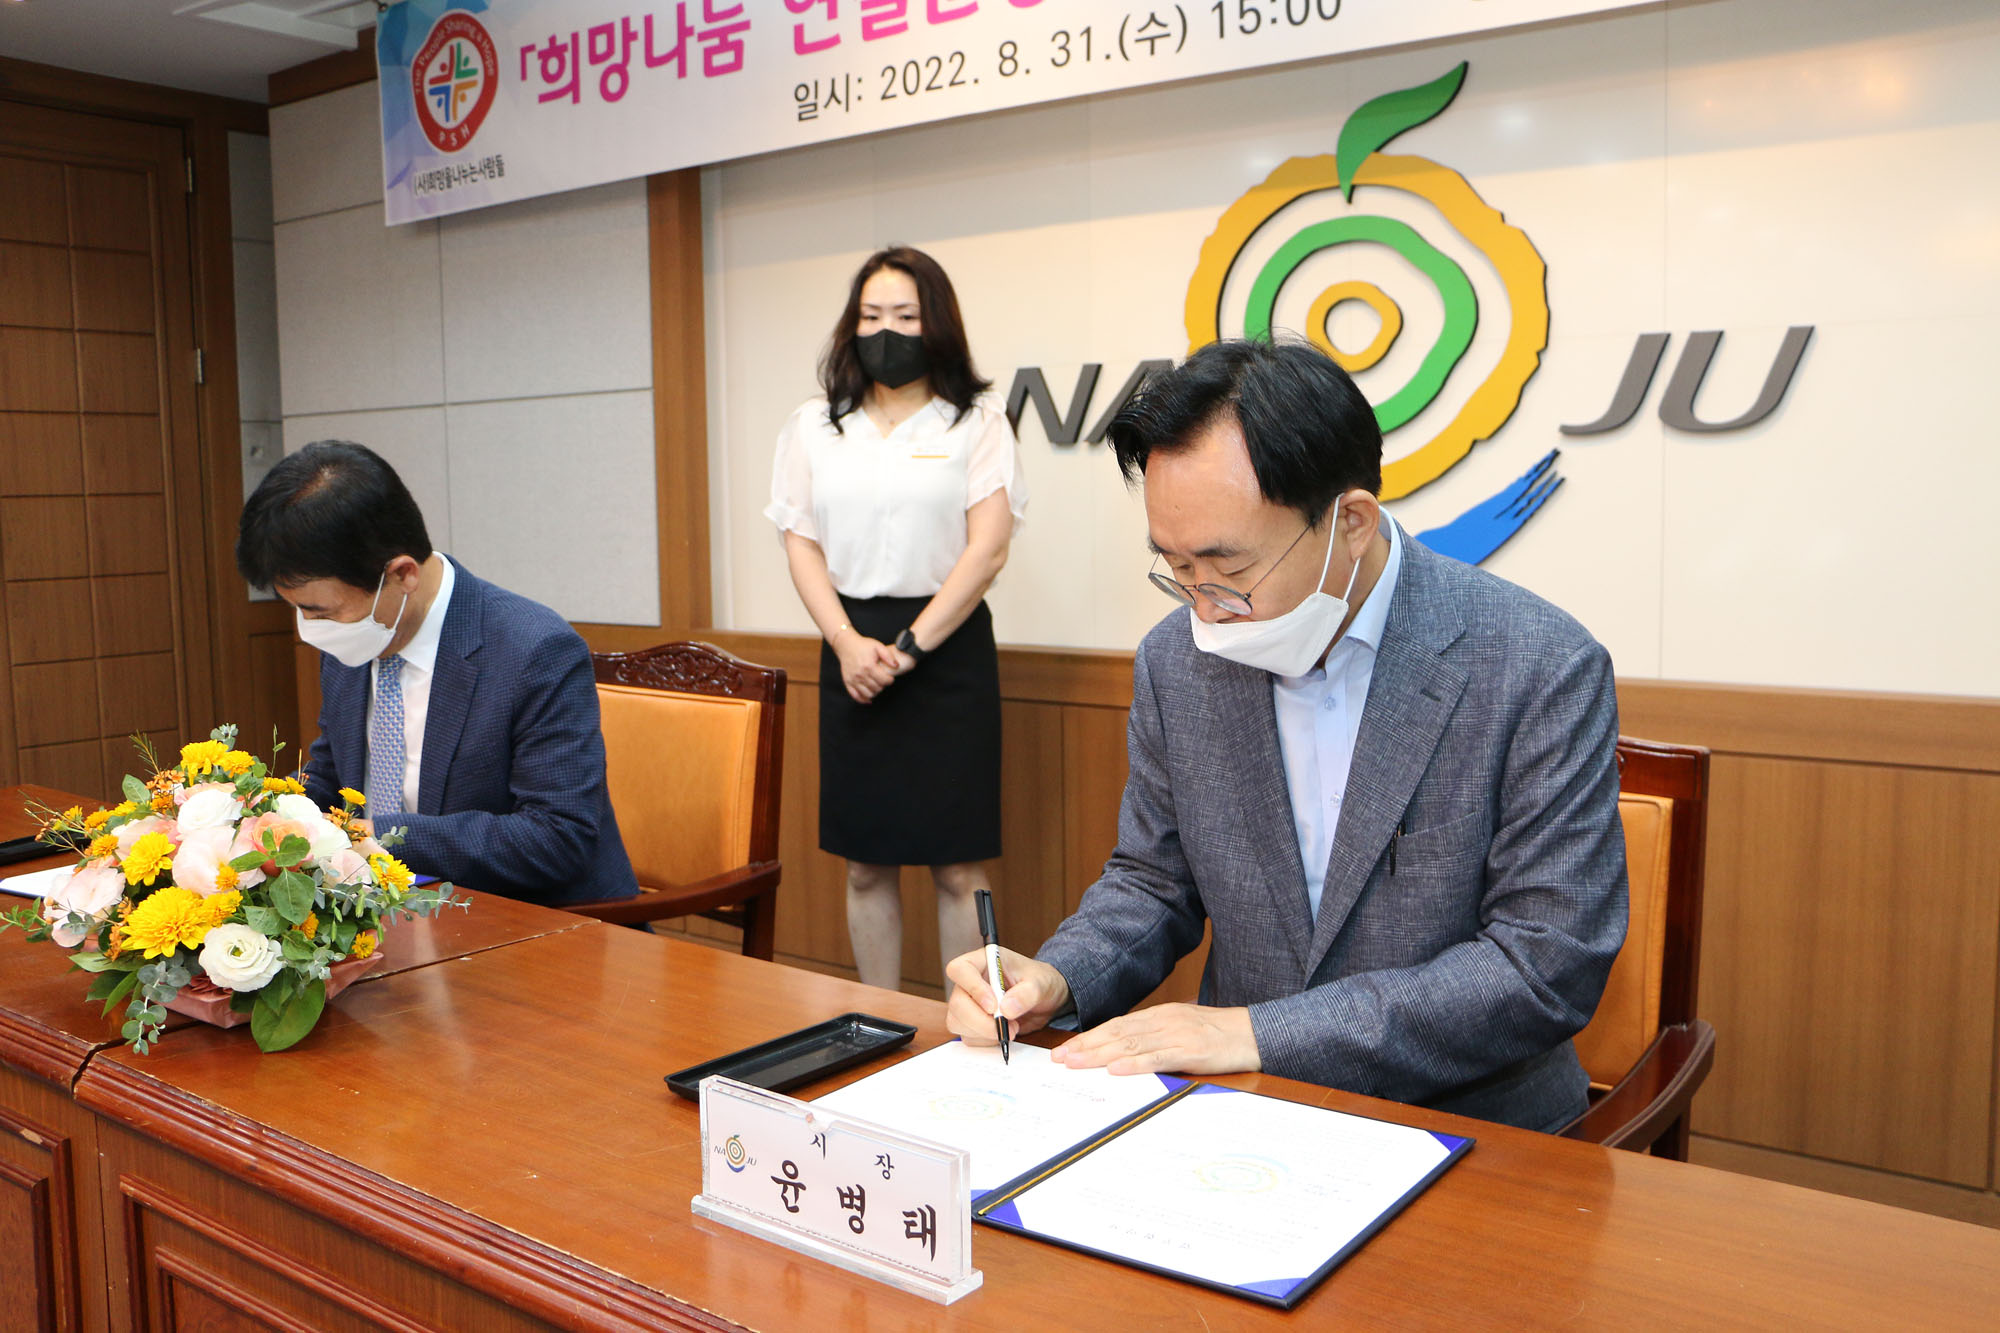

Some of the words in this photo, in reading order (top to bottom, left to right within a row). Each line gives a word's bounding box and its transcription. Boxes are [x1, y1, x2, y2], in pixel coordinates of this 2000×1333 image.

[794, 73, 864, 122] 일시:
[880, 51, 980, 100] 2022.
[998, 40, 1031, 77] 8.
[1211, 0, 1342, 39] 15:00
